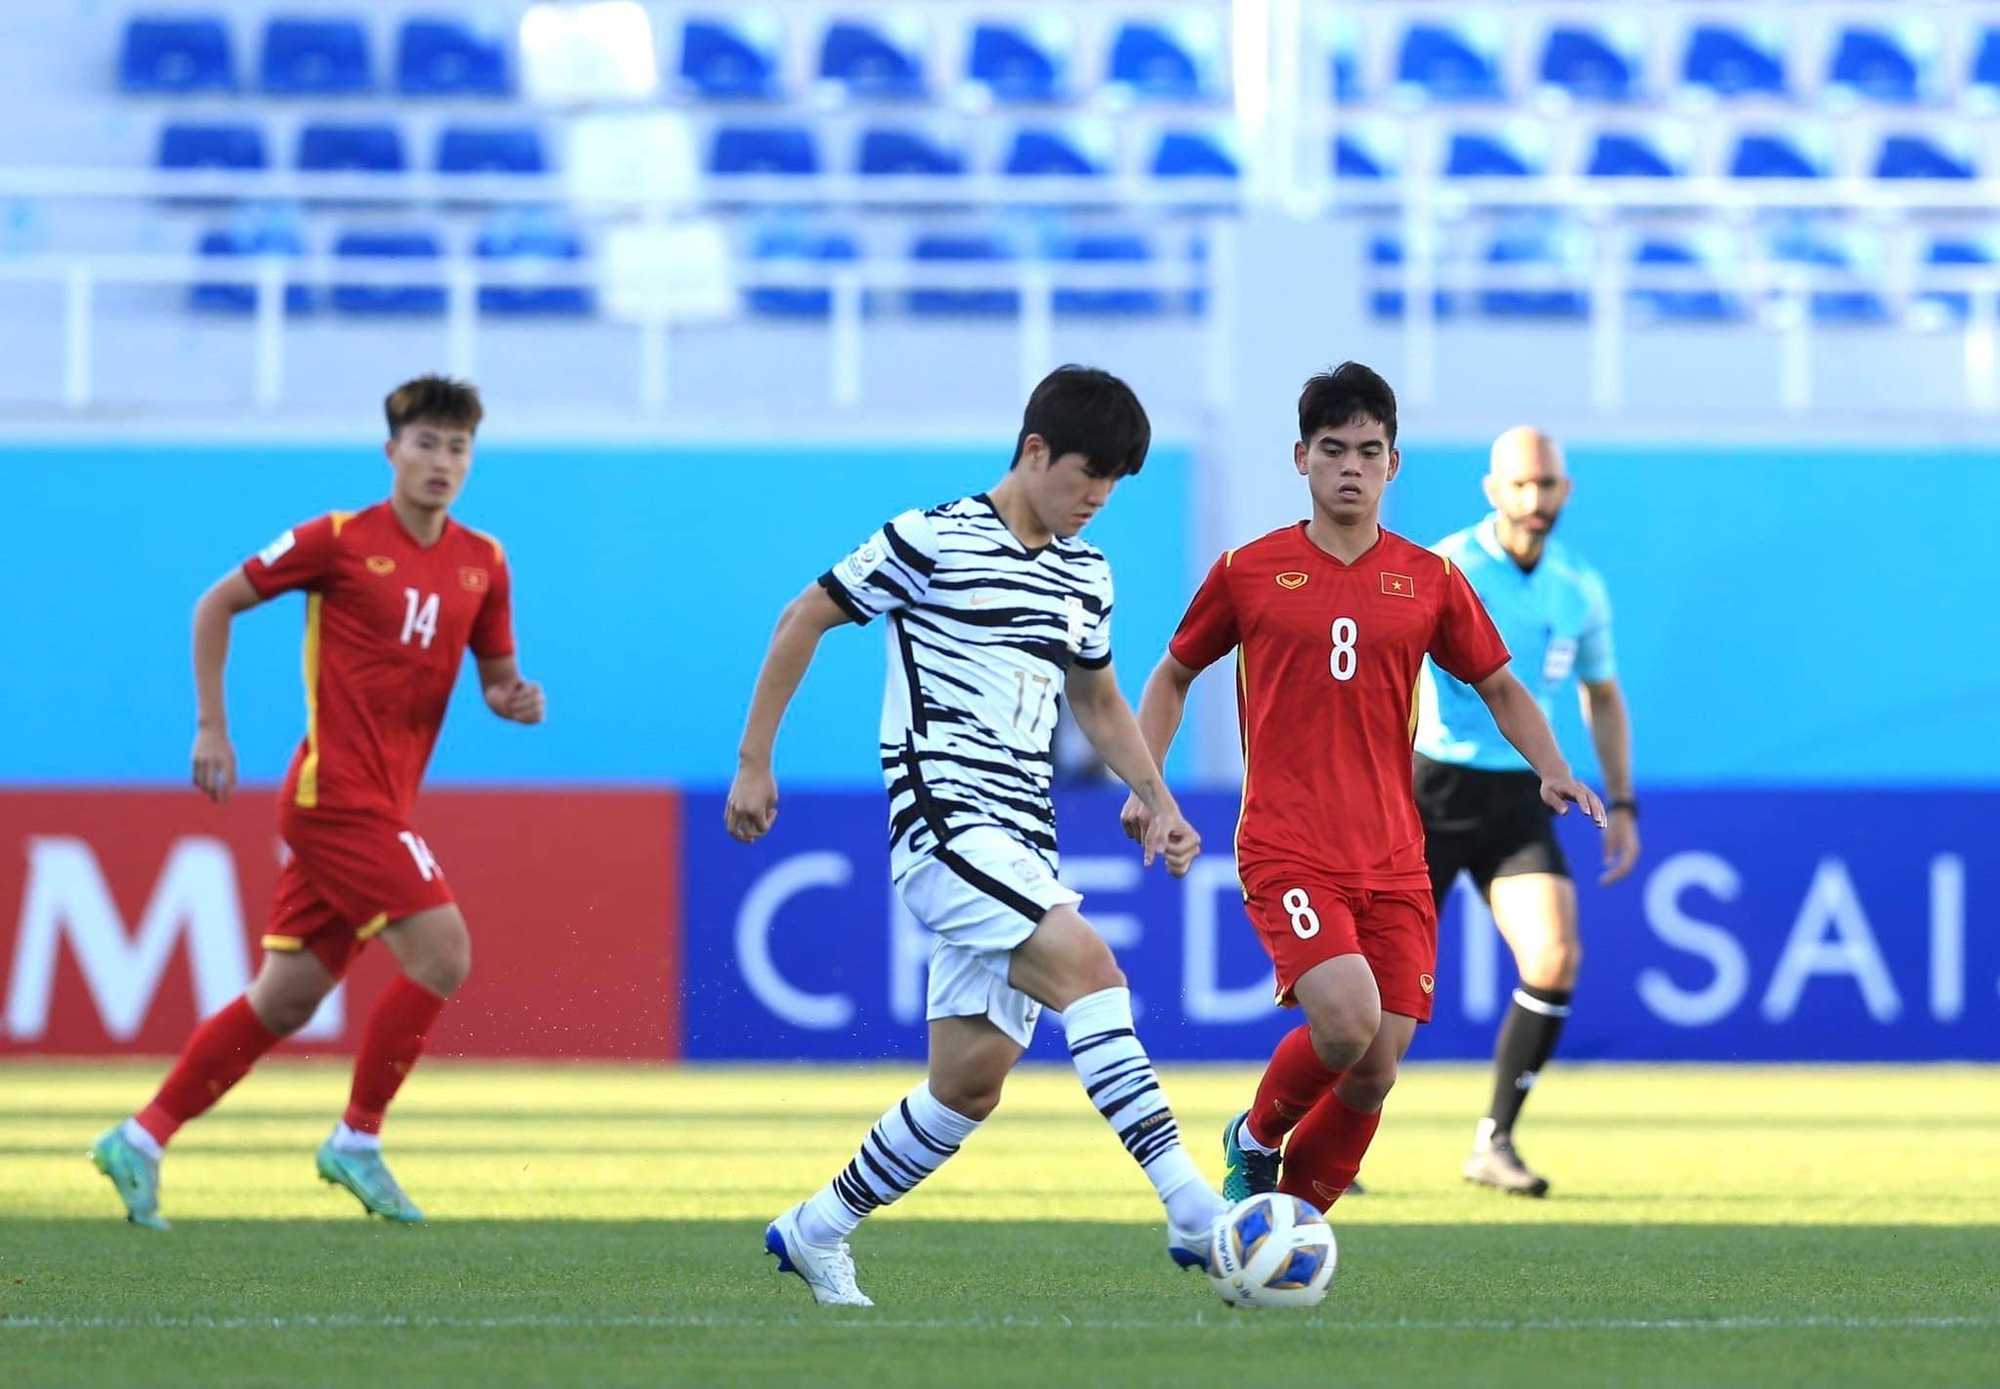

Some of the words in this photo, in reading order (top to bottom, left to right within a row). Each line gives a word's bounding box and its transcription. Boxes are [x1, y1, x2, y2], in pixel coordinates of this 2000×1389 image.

[401, 586, 440, 649] 14
[1329, 616, 1358, 682] 8
[1012, 670, 1052, 734] 17
[1281, 886, 1321, 940] 8
[1636, 850, 2000, 1027] SAI
